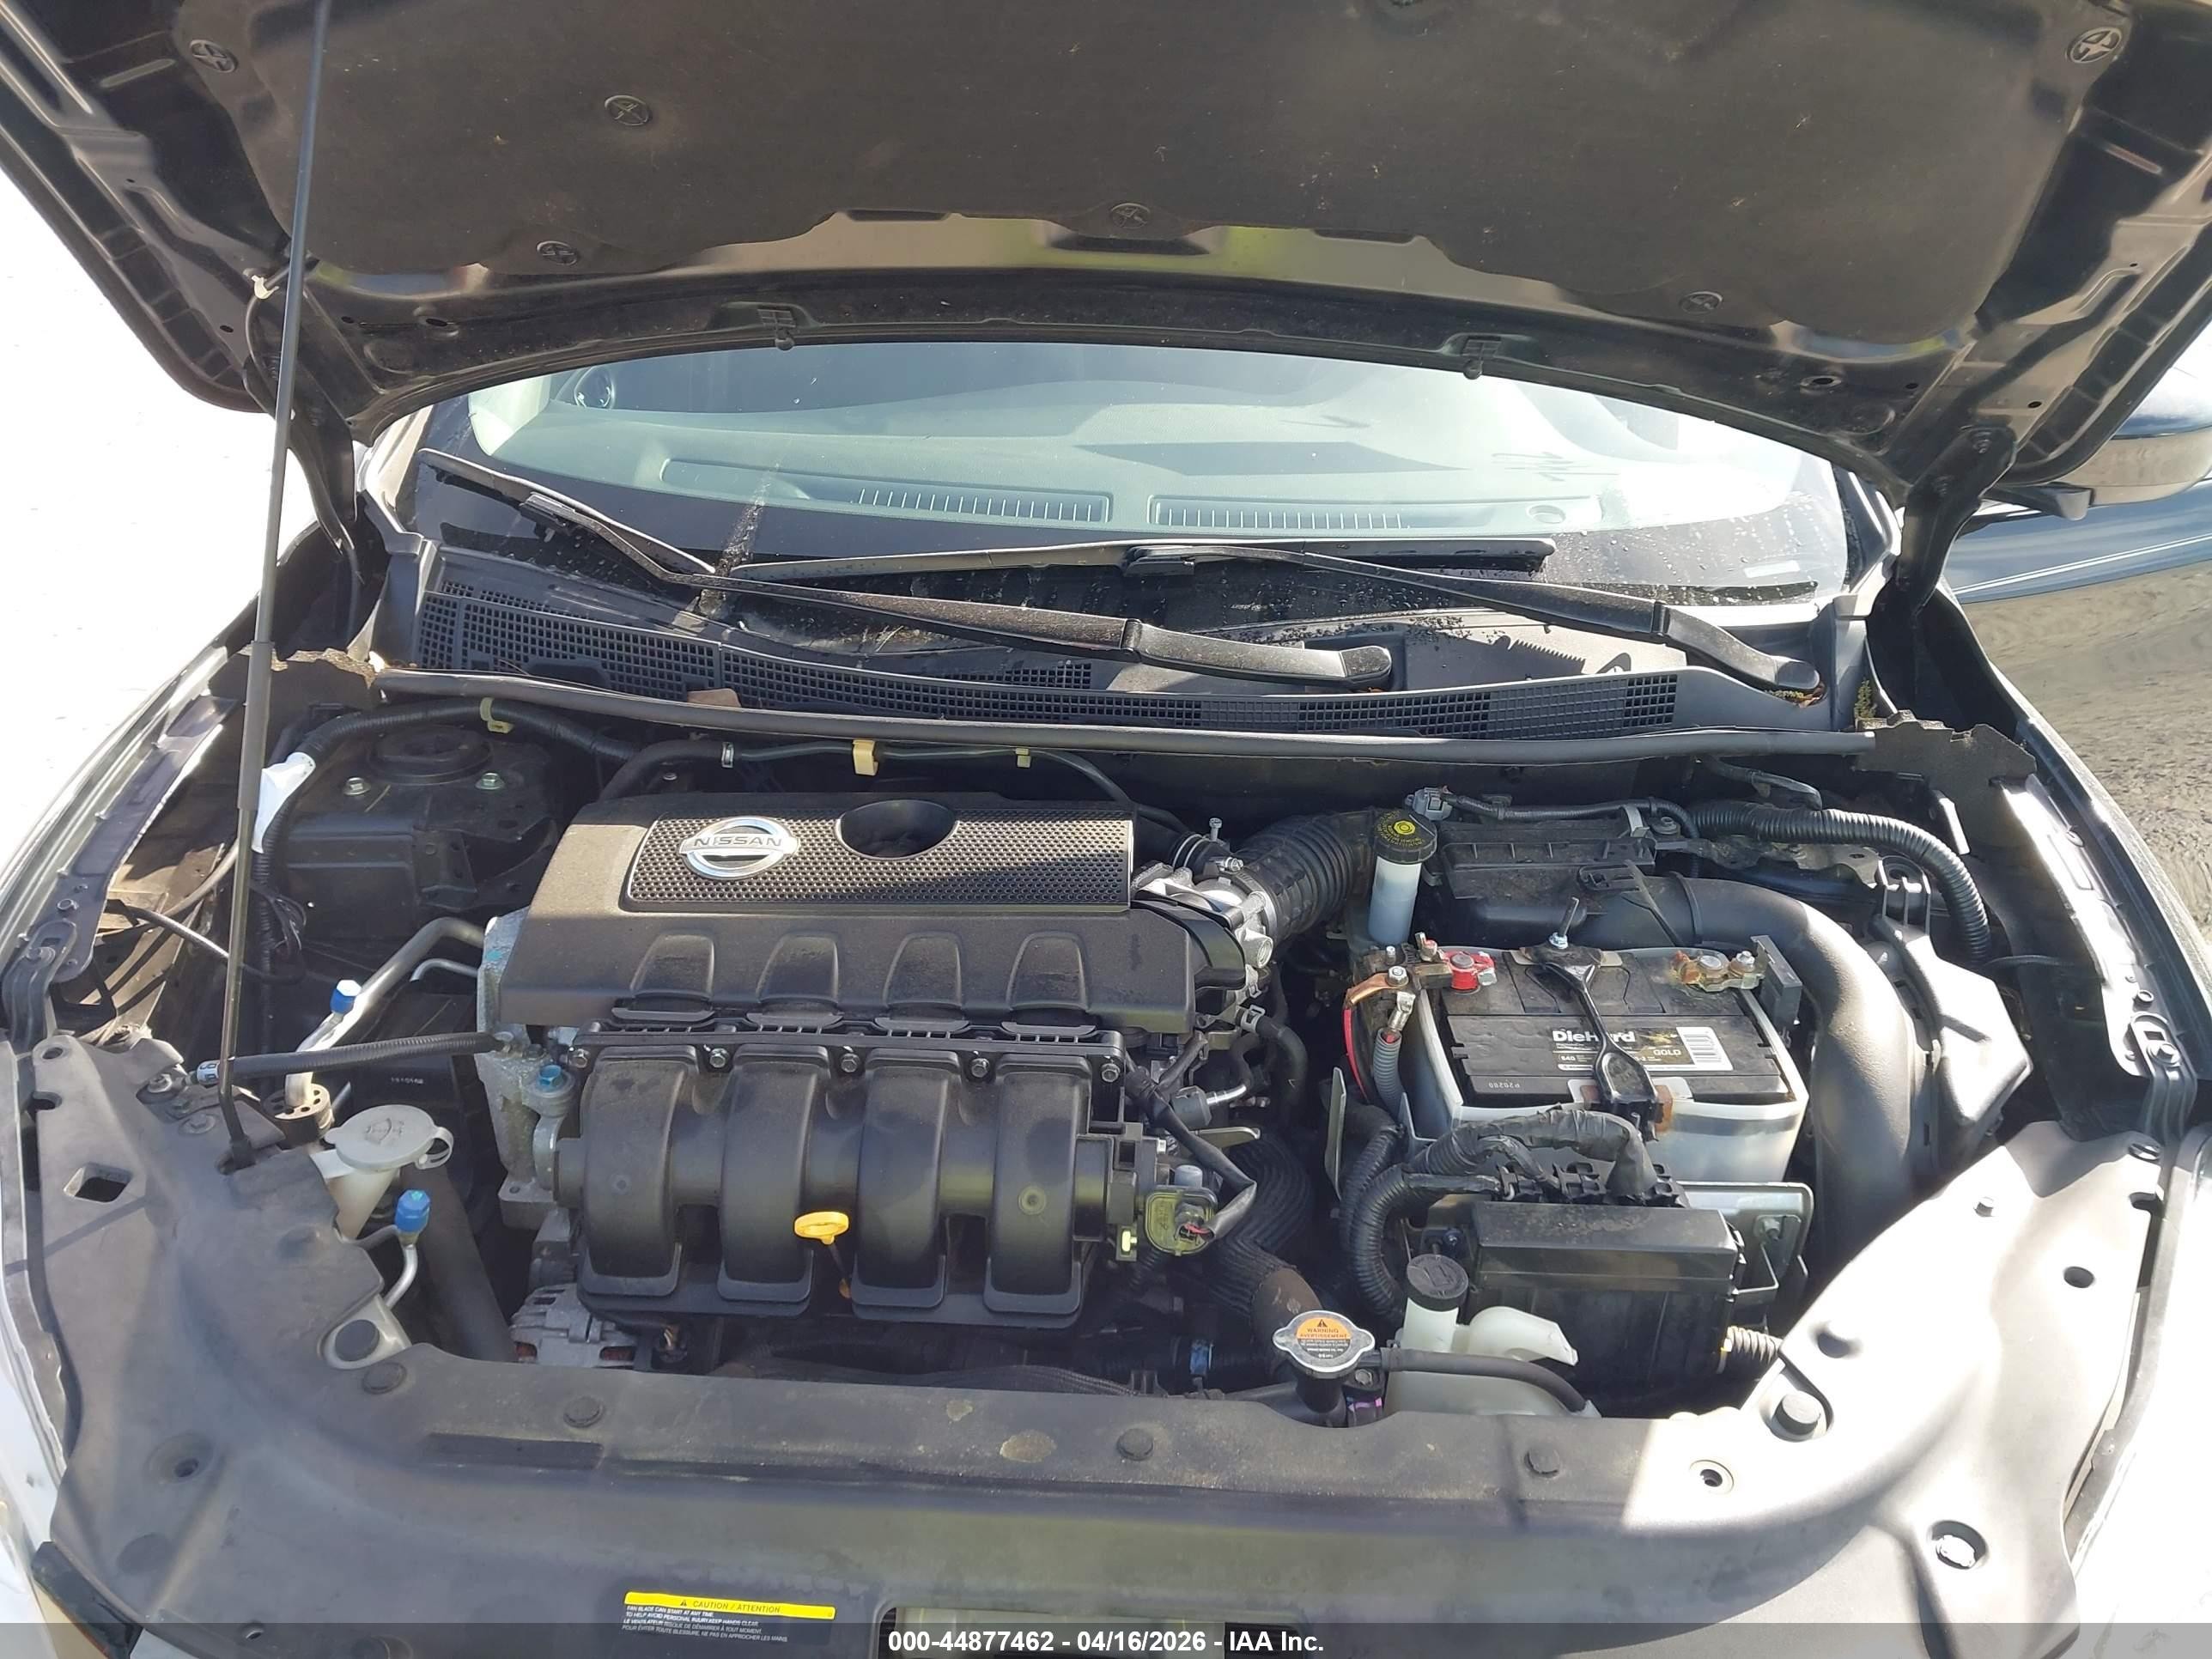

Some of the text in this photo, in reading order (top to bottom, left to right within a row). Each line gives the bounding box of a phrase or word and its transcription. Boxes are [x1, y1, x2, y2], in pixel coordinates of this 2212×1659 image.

[693, 836, 782, 847] NISSAN
[1553, 1030, 1636, 1042] DieHrd
[693, 1601, 729, 1610] CAUTION
[735, 1603, 781, 1613] ATTENTION
